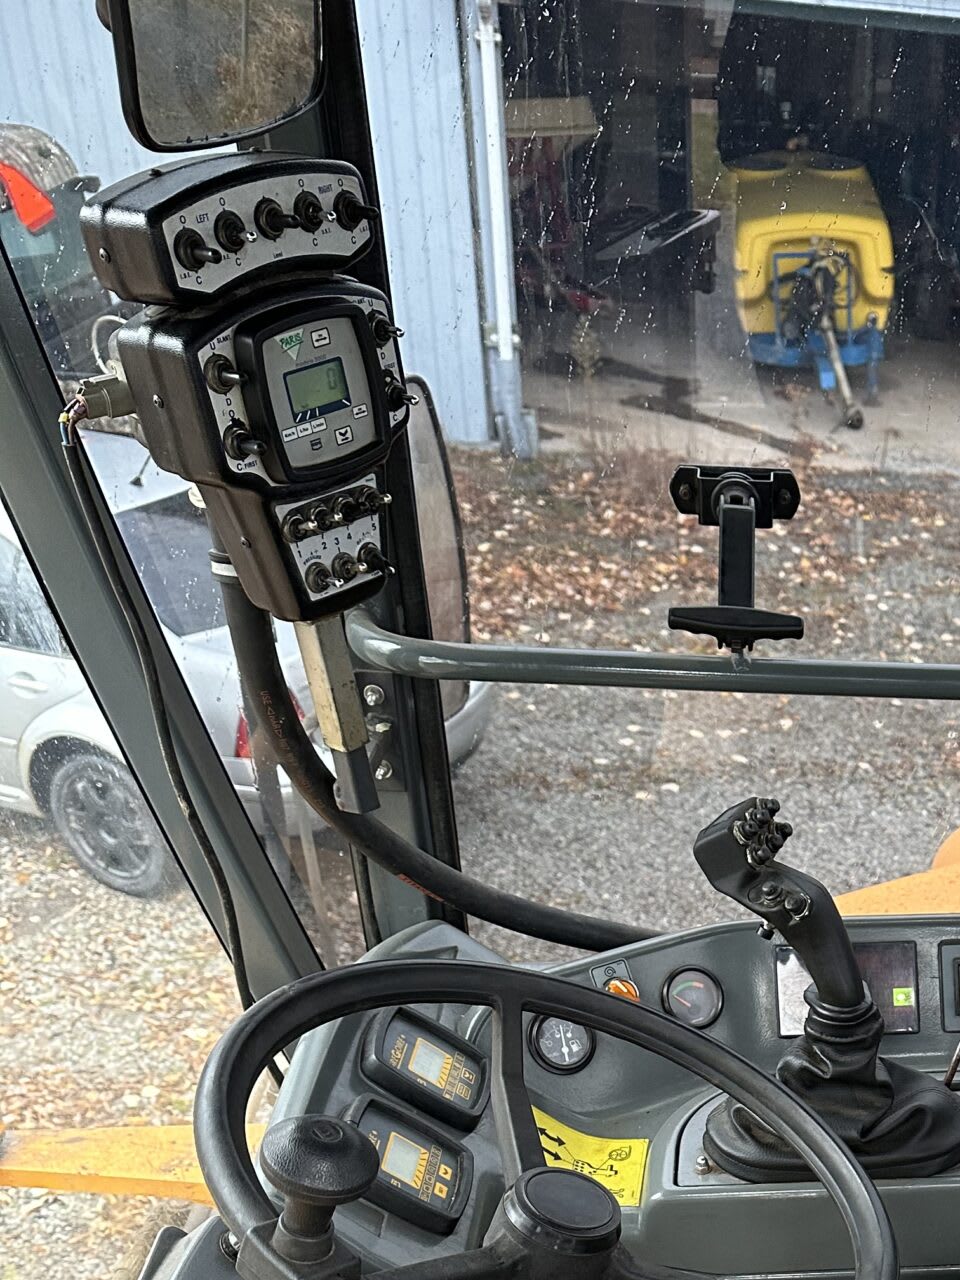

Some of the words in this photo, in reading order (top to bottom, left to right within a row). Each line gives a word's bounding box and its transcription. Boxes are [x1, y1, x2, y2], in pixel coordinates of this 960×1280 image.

[318, 184, 333, 195] RIGHT
[195, 213, 210, 224] LEFT
[312, 237, 319, 247] C
[351, 235, 357, 245] C
[235, 257, 242, 267] C
[195, 275, 203, 285] C
[209, 342, 216, 351] U
[225, 398, 232, 406] D
[236, 462, 243, 471] C
[244, 460, 258, 470] FIRST
[371, 523, 377, 531] 5
[334, 537, 340, 545] 3
[347, 532, 352, 540] 4
[321, 542, 327, 550] 2
